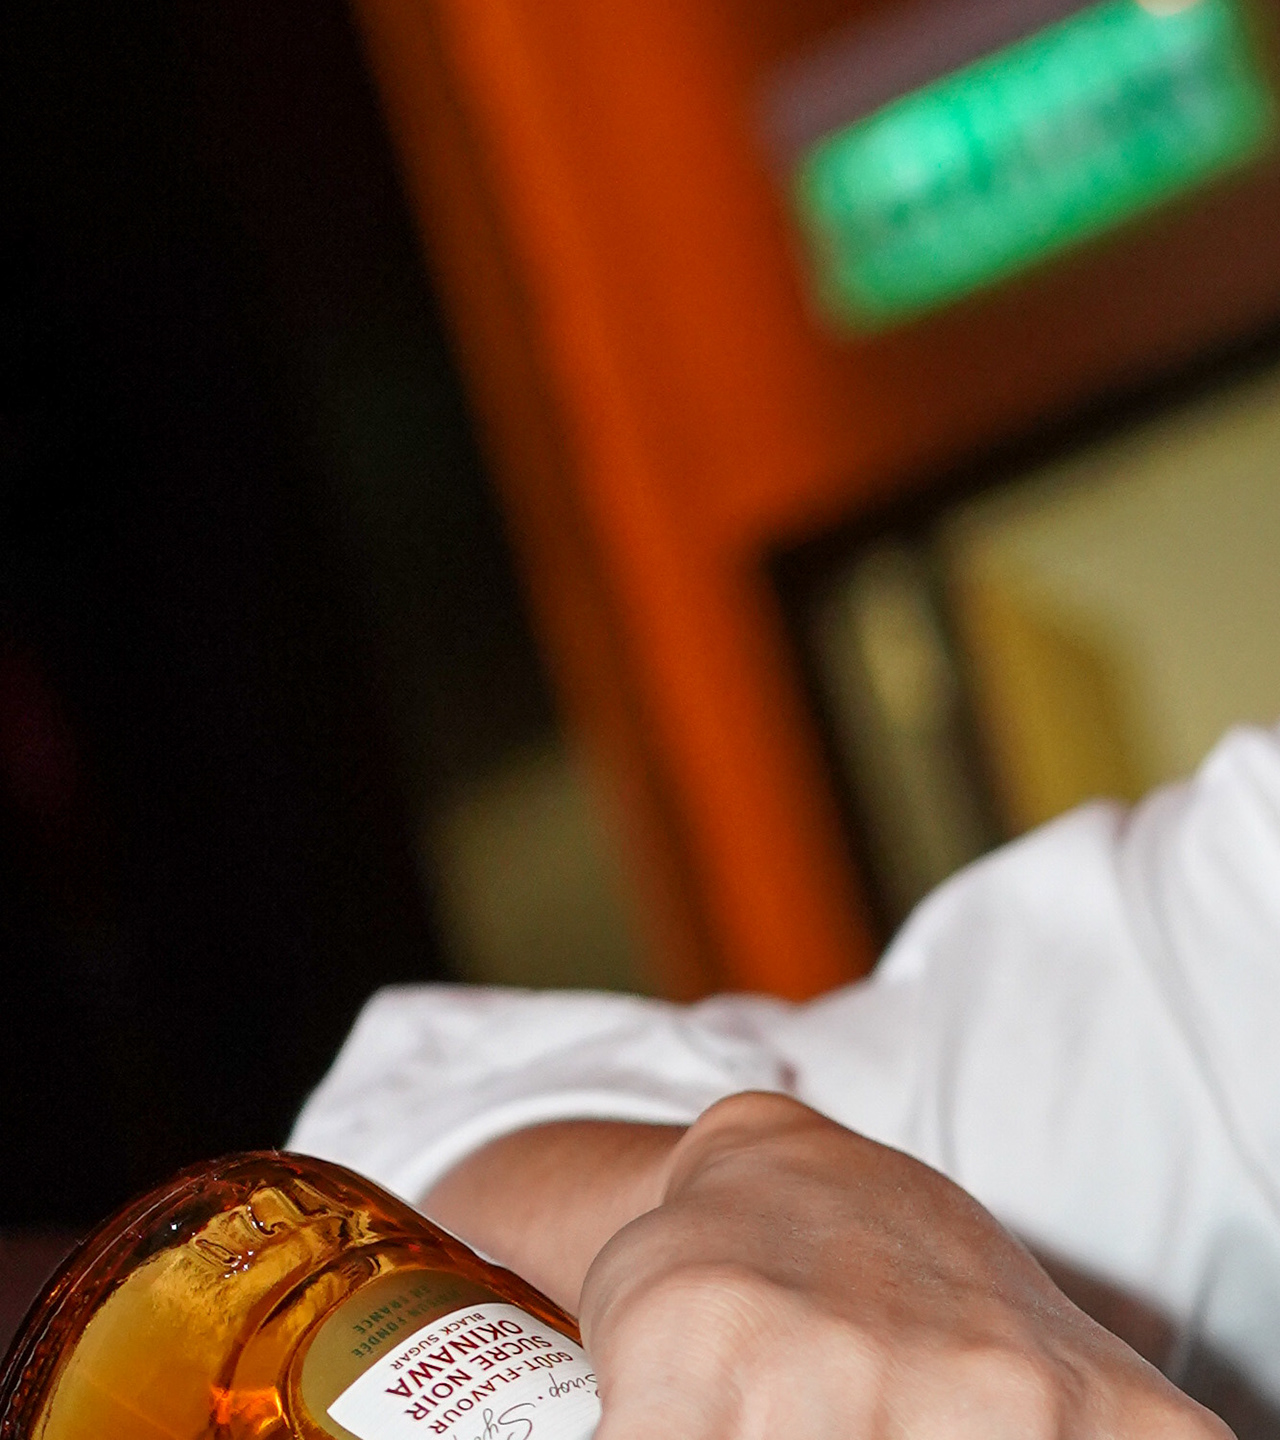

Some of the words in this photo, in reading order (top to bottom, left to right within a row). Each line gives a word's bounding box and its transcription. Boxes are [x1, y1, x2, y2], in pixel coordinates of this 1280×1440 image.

[439, 1312, 486, 1336] BLACK
[384, 1319, 524, 1399] OKINAWA
[389, 1334, 440, 1371] SUGAR
[469, 1335, 553, 1371] SUCRE
[403, 1368, 473, 1421] NOIR
[428, 1350, 574, 1435] GOÛT-FLAVOUR
